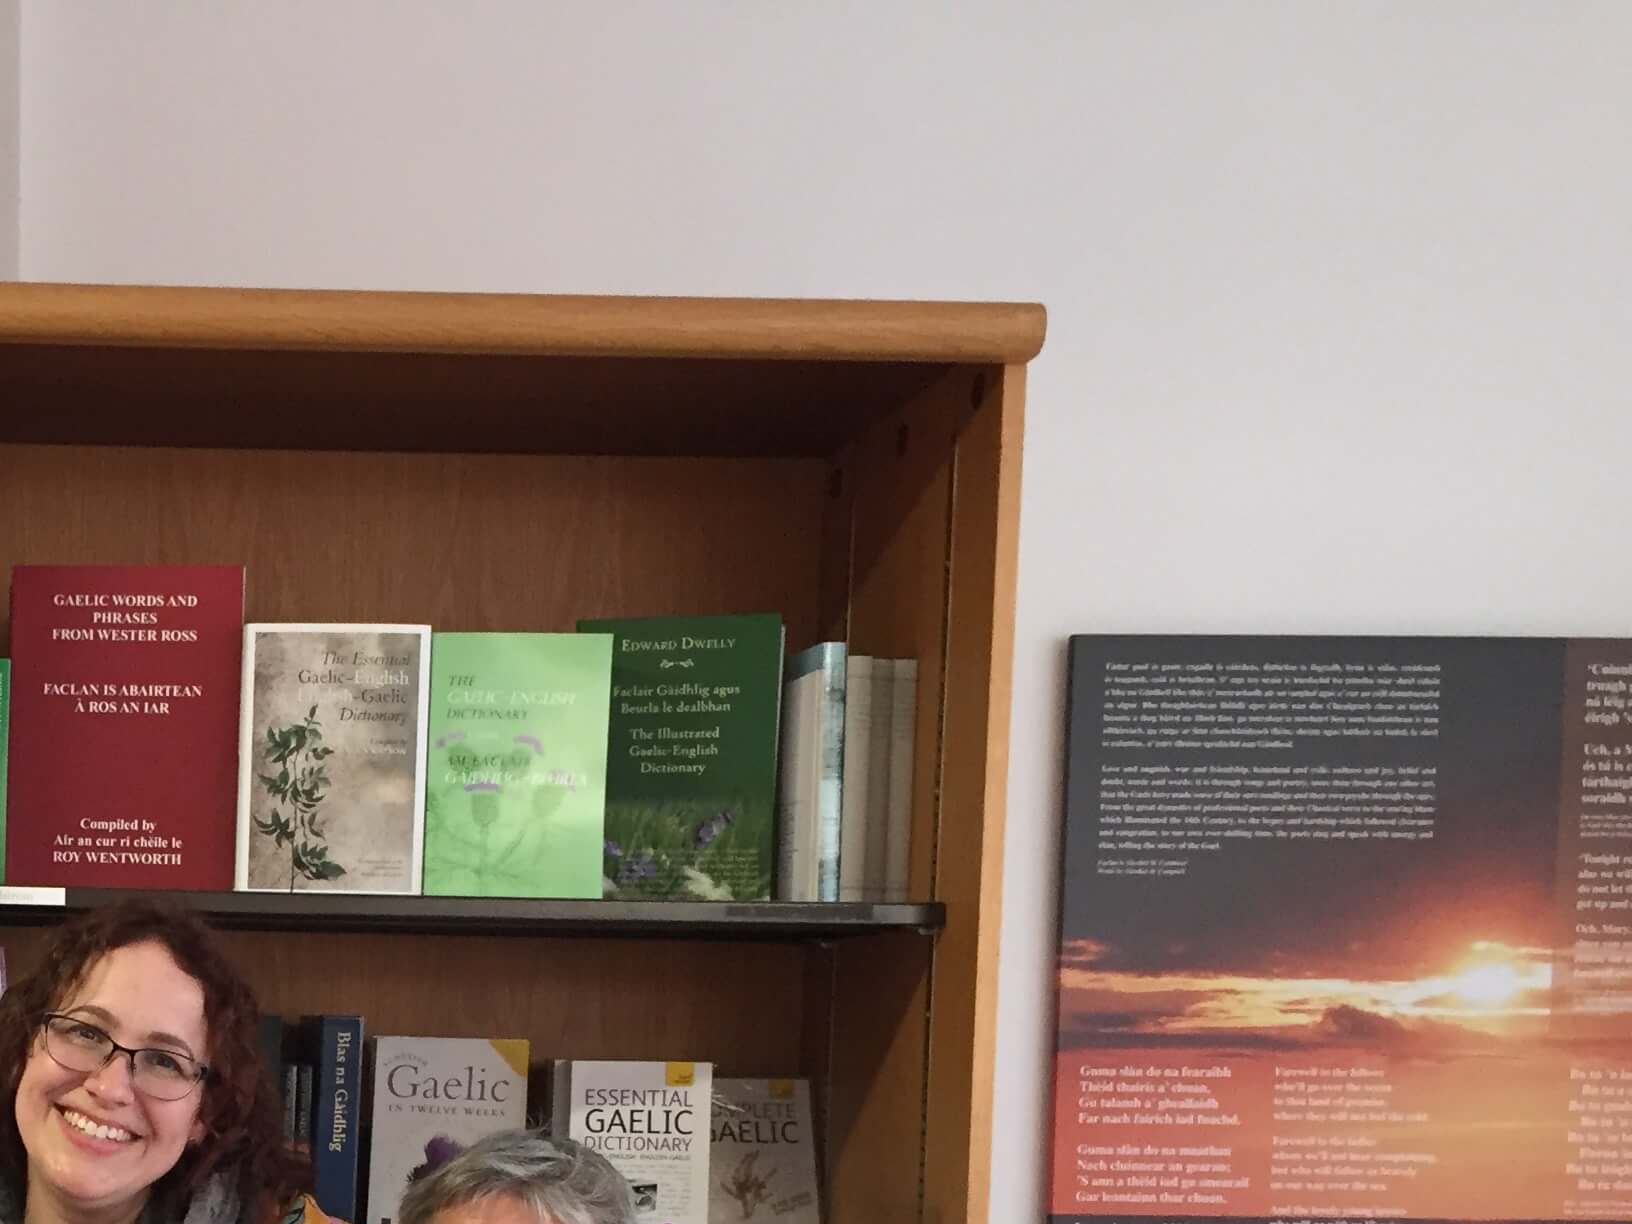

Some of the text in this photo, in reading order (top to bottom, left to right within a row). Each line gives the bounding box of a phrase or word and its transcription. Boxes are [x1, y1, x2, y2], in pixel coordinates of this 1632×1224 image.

[54, 594, 197, 607] GAELIC WORDS AND
[93, 612, 157, 623] PHRASES
[53, 629, 197, 641] FROM WESTER ROSS
[43, 683, 202, 697] FACLAN IS ABAIRTEAN
[613, 685, 653, 697] Faclair
[713, 686, 740, 697] agus
[89, 702, 117, 713] ROS
[120, 702, 139, 713] AN
[144, 702, 169, 714] IAR
[621, 701, 731, 714] Beurla le dealbhan
[340, 707, 407, 726] Dictionary
[629, 726, 720, 740] The Illustrated
[641, 762, 706, 775] Dictionary
[80, 818, 157, 833] Compiled by
[54, 834, 73, 846] Air
[78, 838, 92, 846] an
[96, 838, 116, 847] cur
[120, 836, 130, 847] ri
[172, 837, 182, 849] le
[53, 851, 181, 865] ROY WENTWORTH
[337, 1032, 351, 1067] Blas
[335, 1067, 345, 1085] na
[387, 1064, 510, 1102] Gaelic
[584, 1088, 693, 1107] ESSENTIAL
[389, 1104, 505, 1117] IN TWELVE WEEKS
[711, 1103, 794, 1119] OMPLETE
[585, 1109, 693, 1135] GAELIC
[583, 1135, 692, 1151] DICTIONARY
